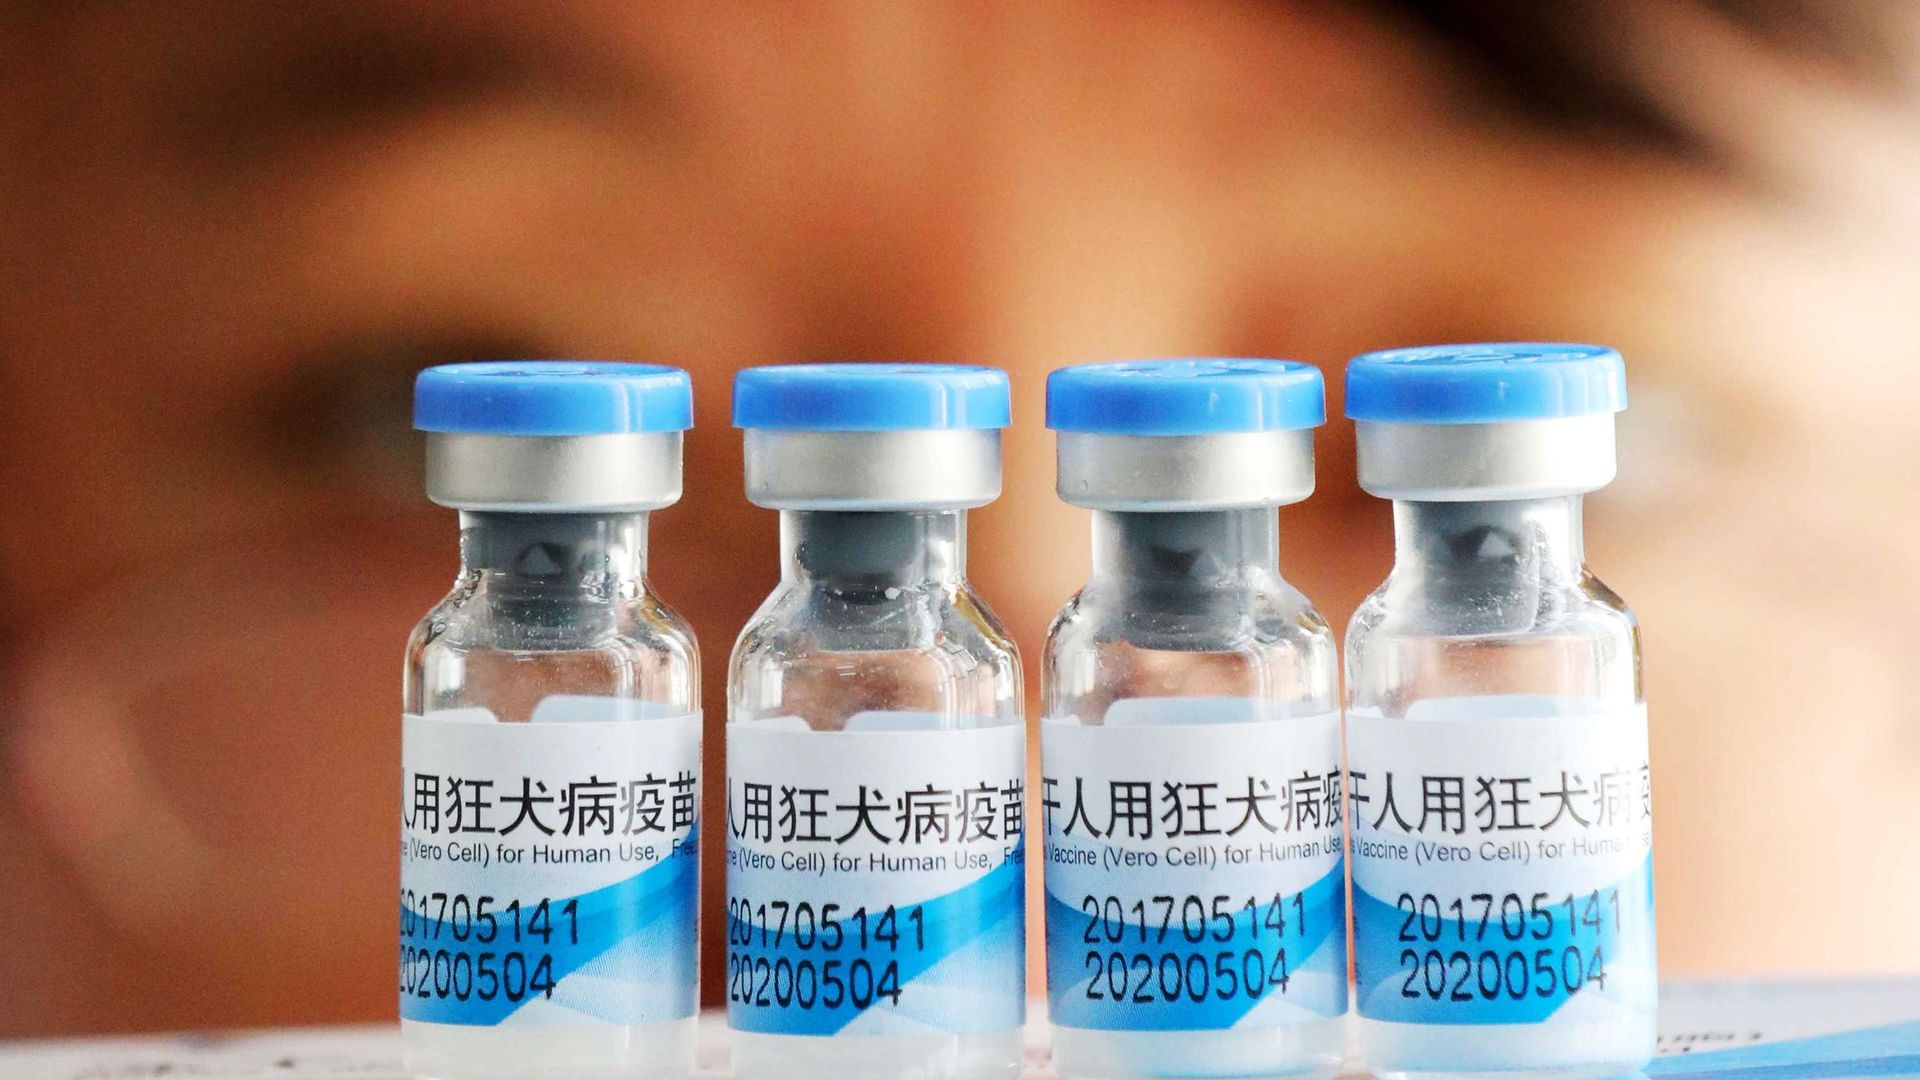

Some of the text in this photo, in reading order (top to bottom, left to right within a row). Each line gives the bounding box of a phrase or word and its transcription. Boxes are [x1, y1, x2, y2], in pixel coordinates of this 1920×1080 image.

[410, 838, 442, 862] (Vero
[447, 841, 489, 868] Cell)
[497, 844, 525, 863] for
[533, 844, 611, 864] Human
[619, 842, 660, 863] Use,
[739, 847, 775, 872] (Vero
[781, 851, 826, 876] Cell)
[833, 853, 861, 872] for
[869, 852, 947, 873] Human
[954, 850, 993, 872] Use,
[1048, 842, 1097, 865] Vaccine
[1103, 847, 1158, 871] (Vero
[1166, 846, 1216, 870] Cell)
[1224, 846, 1252, 864] for
[1259, 840, 1320, 862] Human
[1356, 839, 1408, 861] Vaccine
[1415, 841, 1471, 866] (Vero
[1479, 840, 1529, 864] Cell)
[1538, 840, 1565, 859] for
[730, 896, 924, 952] 201705141
[1082, 892, 1305, 944] 201705141
[1397, 889, 1621, 943] 201705141
[731, 952, 902, 1010] 20200504
[1086, 947, 1289, 1004] 20200504
[1401, 945, 1607, 1002] 20200504
